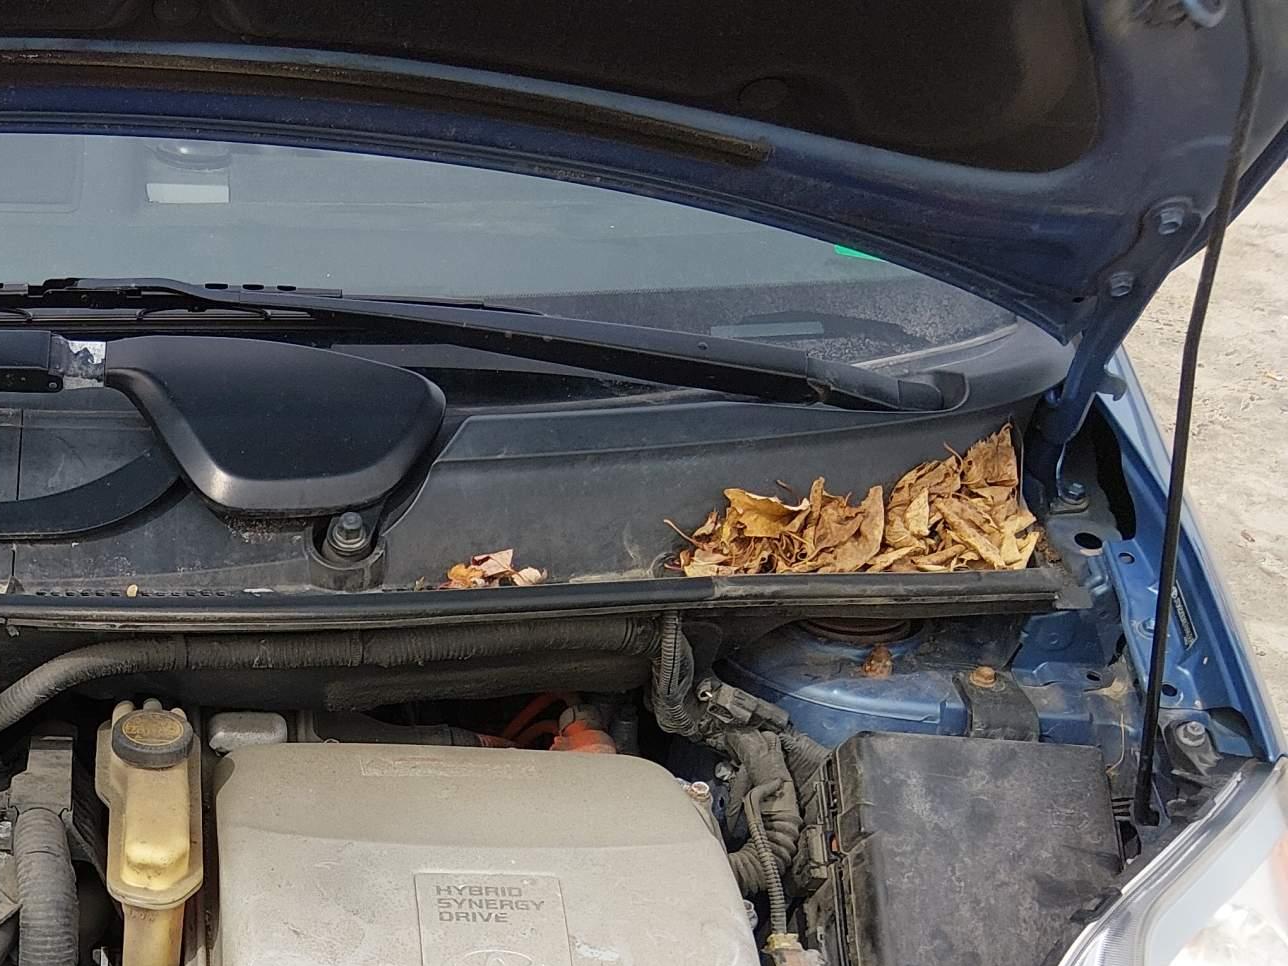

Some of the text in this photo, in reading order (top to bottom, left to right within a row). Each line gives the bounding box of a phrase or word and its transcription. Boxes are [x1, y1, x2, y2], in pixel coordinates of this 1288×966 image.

[437, 885, 522, 897] HYBRID
[437, 898, 544, 911] SYNERGY
[439, 911, 509, 923] DRIVE
